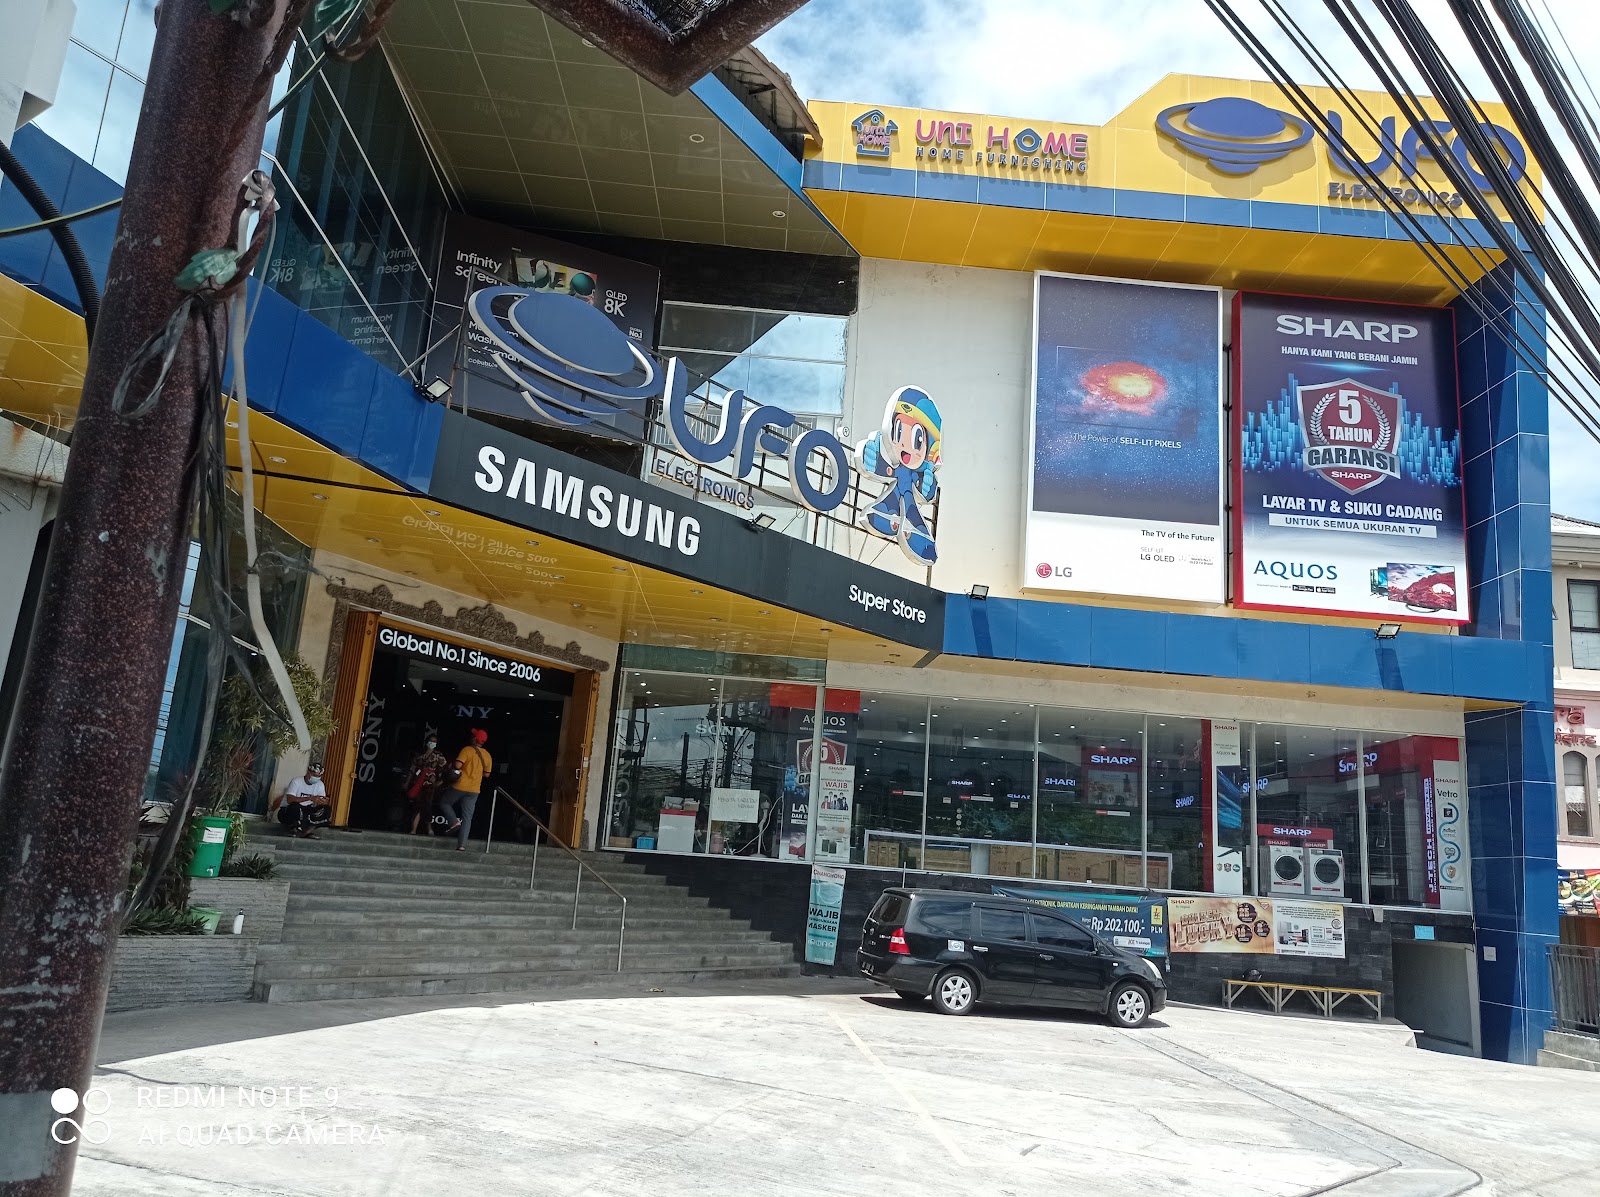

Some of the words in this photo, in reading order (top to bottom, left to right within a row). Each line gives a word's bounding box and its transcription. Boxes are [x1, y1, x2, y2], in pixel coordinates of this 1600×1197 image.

[986, 126, 1088, 158] HOME
[916, 147, 964, 161] HOME
[976, 152, 1087, 172] FURNISHING
[1327, 182, 1464, 208] ELECTRONICS
[456, 250, 502, 273] Infinity
[605, 289, 628, 302] QLED
[604, 298, 626, 317] 8K
[1275, 314, 1419, 344] SHARP
[1281, 346, 1309, 356] HANYA
[1311, 348, 1333, 358] KAMI
[1334, 350, 1356, 360] YANG
[1358, 352, 1389, 363] BERANI
[1391, 354, 1418, 365] JAMIN
[1338, 388, 1362, 425] 5
[663, 356, 850, 512] UFO
[1120, 437, 1153, 446] SELF-LIT
[1328, 425, 1373, 443] TAHUN
[1307, 447, 1396, 473] GARANSI
[652, 457, 755, 510] ELECTRONICS
[1331, 471, 1372, 480] SHARP
[474, 445, 701, 556] SAMSUNG
[1262, 494, 1306, 511] LAYAR
[1308, 498, 1326, 512] TV
[1329, 500, 1341, 513] &
[1344, 501, 1382, 516] SUKU
[1385, 504, 1443, 521] CADANG
[1141, 529, 1155, 537] The
[1156, 530, 1166, 538] TV
[1177, 532, 1189, 540] the
[1191, 533, 1215, 541] Future
[1285, 517, 1321, 527] UNTUK
[1323, 519, 1360, 530] SEMUA
[1362, 522, 1406, 534] UKURAN
[1408, 526, 1421, 535] TV
[1140, 553, 1151, 561] LG
[1153, 554, 1175, 563] OLED
[1055, 566, 1073, 578] LG
[1253, 559, 1338, 580] AQUOS
[849, 584, 890, 612] Super
[892, 598, 926, 624] Store
[379, 628, 434, 656] Global
[436, 644, 466, 664] No.1
[468, 650, 507, 675] Since
[510, 662, 541, 683] 2006
[358, 692, 386, 783] SONY
[825, 781, 848, 789] WAJIB
[1437, 788, 1459, 798] Vetro
[1175, 796, 1195, 807] SHARP
[1273, 827, 1312, 836] SHARP
[809, 907, 839, 920] WAJIB
[1091, 916, 1104, 934] Rp
